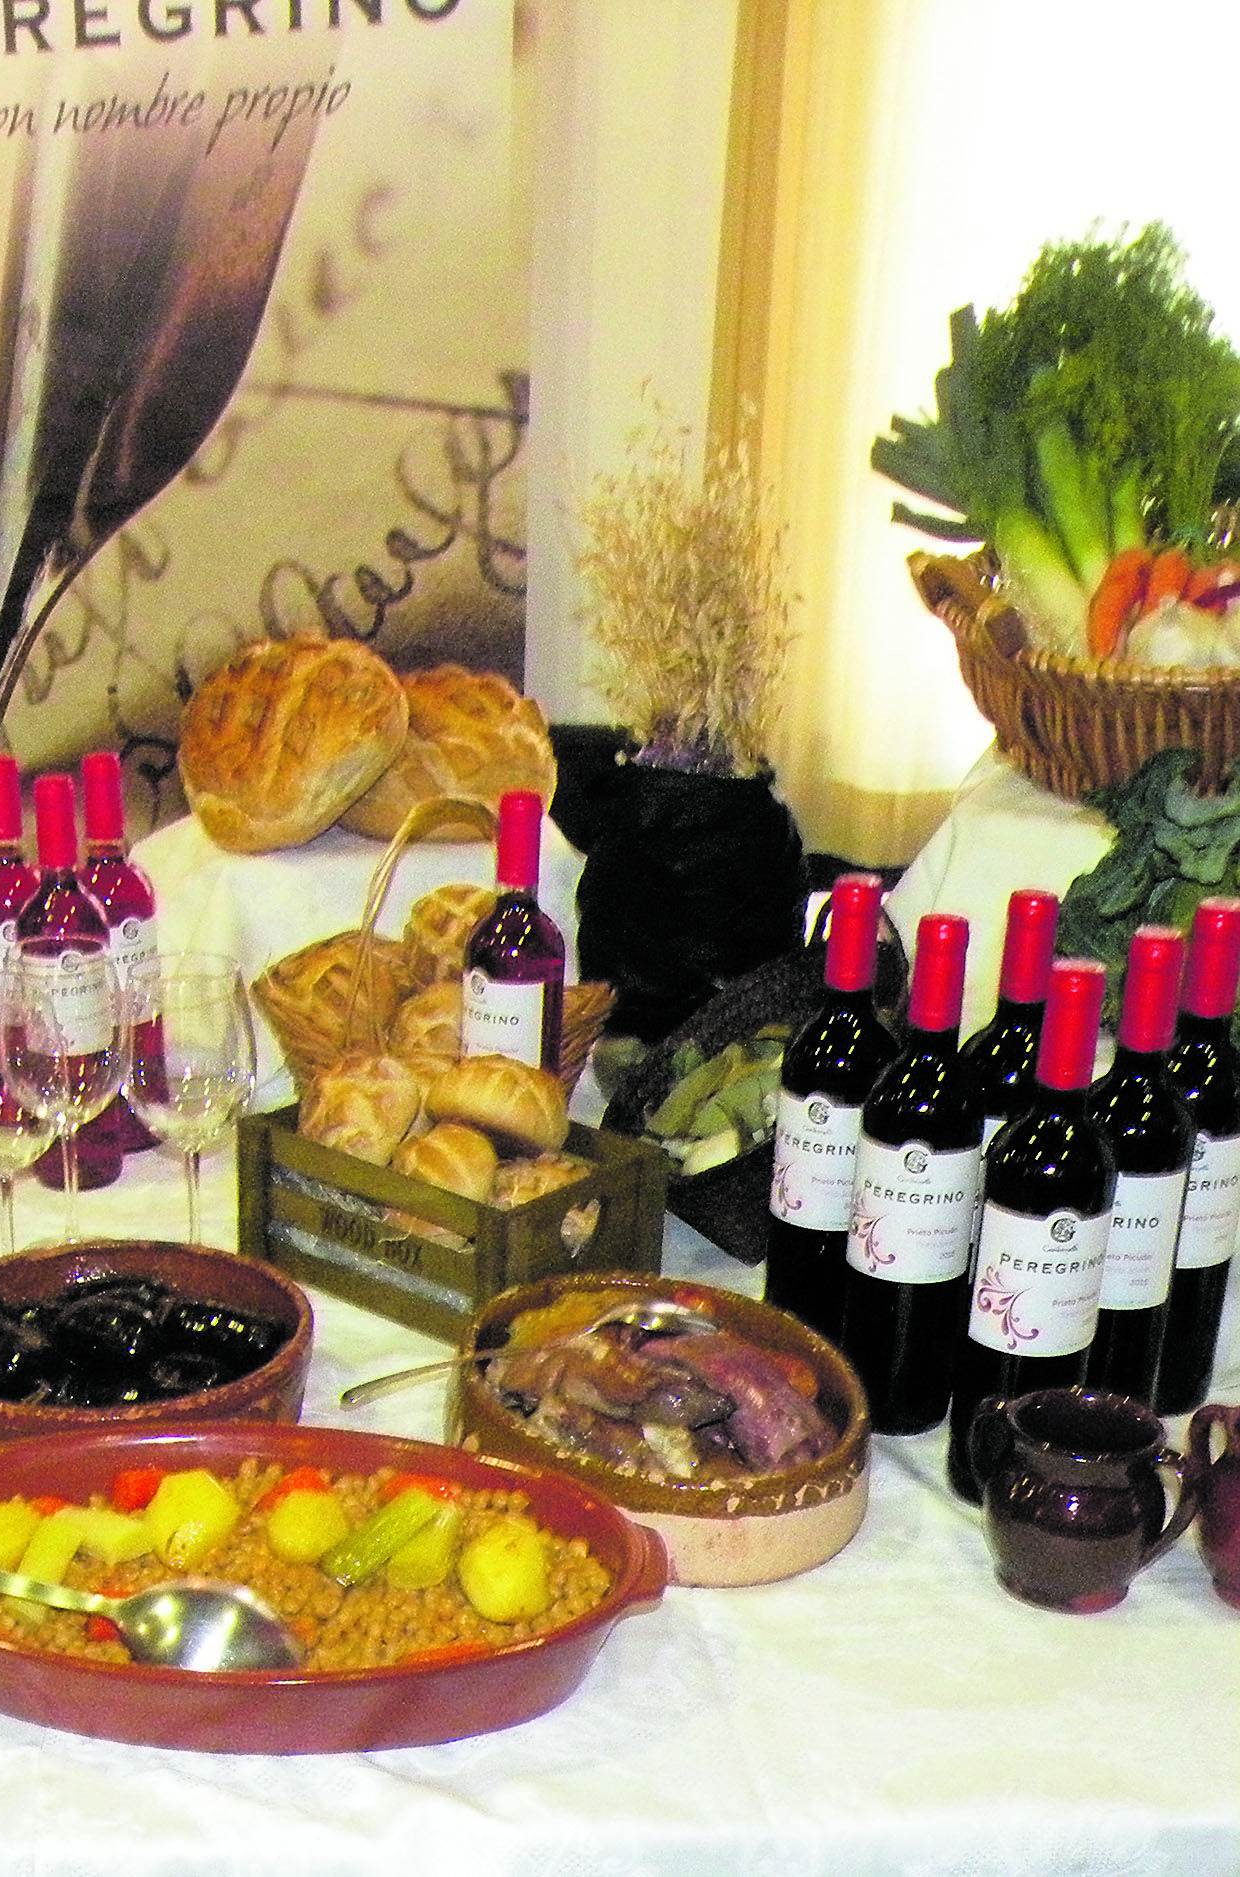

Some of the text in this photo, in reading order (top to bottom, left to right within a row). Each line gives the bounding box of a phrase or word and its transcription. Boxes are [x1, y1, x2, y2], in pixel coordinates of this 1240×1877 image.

[53, 72, 204, 134] nombre
[206, 65, 352, 156] propio
[464, 1008, 520, 1026] EGRINO
[779, 1129, 856, 1156] PEREGRIN
[864, 1179, 965, 1205] PEREGRINO
[1187, 1175, 1239, 1192] GRINO
